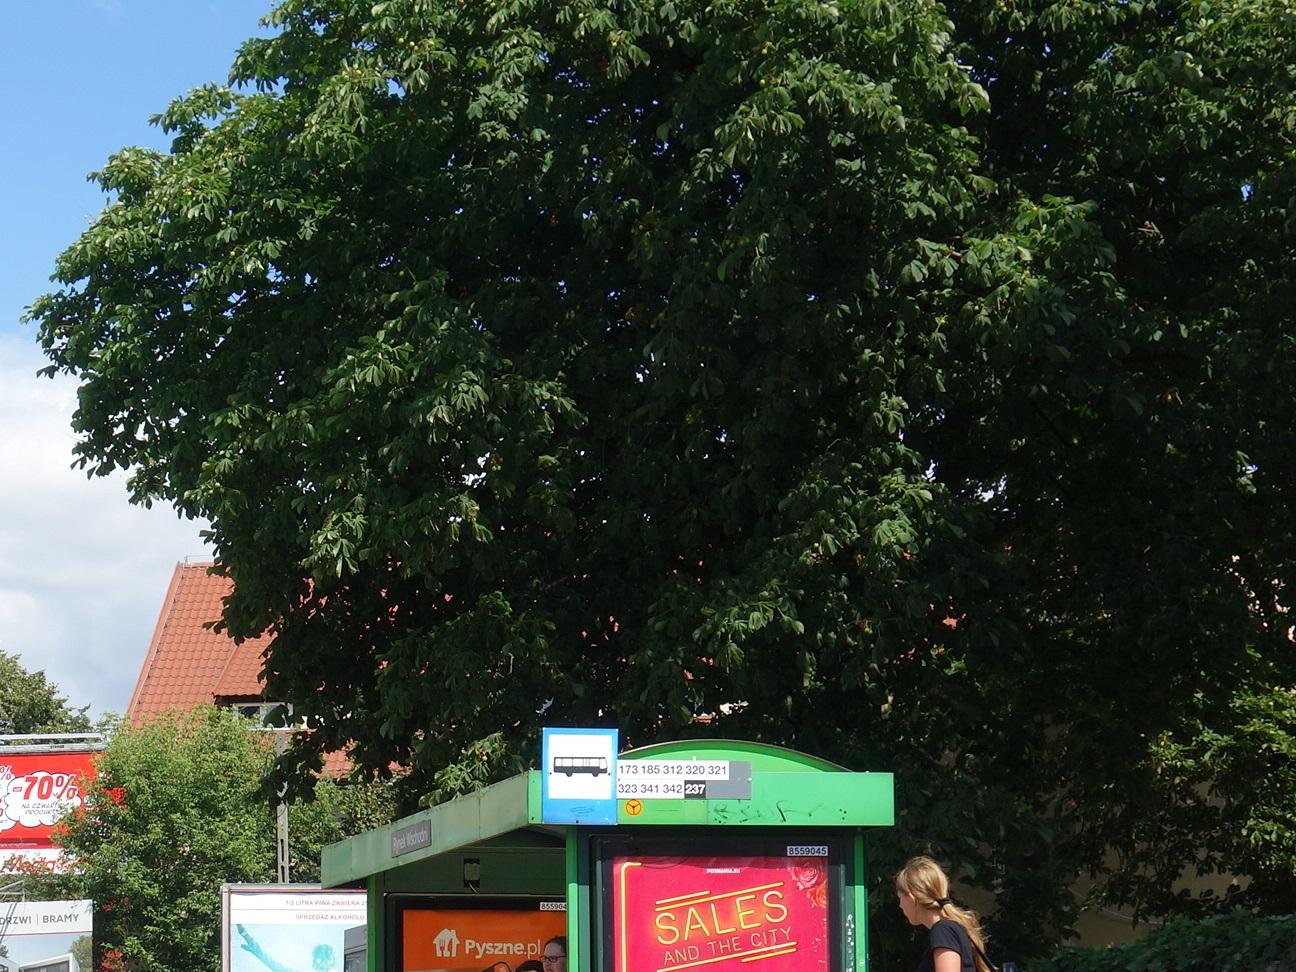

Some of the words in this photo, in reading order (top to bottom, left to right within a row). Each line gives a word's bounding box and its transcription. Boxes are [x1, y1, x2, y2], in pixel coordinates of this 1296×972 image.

[619, 765, 638, 774] 173
[641, 765, 660, 774] 185
[663, 765, 683, 774] 312
[686, 765, 705, 774] 320
[708, 765, 726, 774] 321
[13, 775, 78, 800] -70%
[618, 784, 638, 793] 323
[640, 784, 659, 793] 341
[663, 784, 683, 793] 342
[685, 784, 705, 794] 237
[788, 847, 827, 855] 8559045
[42, 914, 80, 924] BRAMY
[655, 890, 789, 945] SALES
[464, 939, 541, 960] Pyszne.pl
[663, 945, 700, 966] AND
[707, 936, 742, 956] THE
[750, 926, 792, 947] CITY
